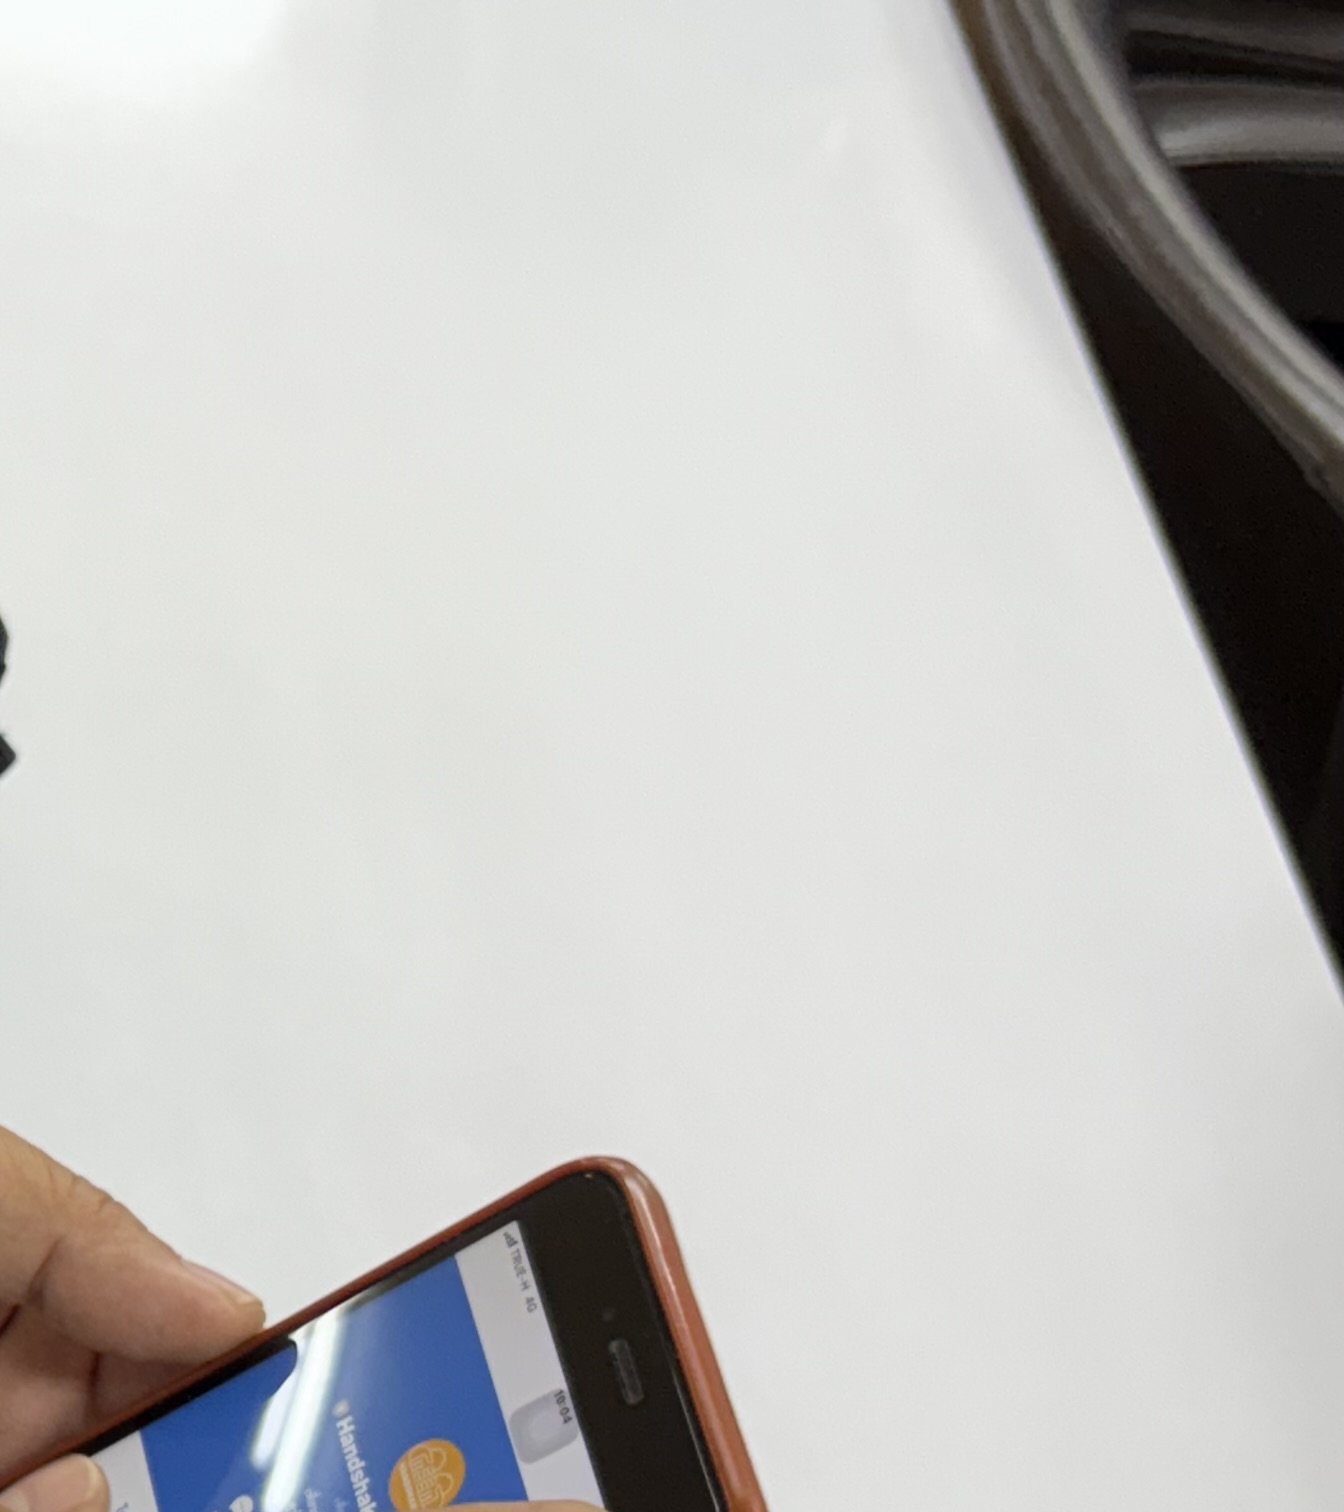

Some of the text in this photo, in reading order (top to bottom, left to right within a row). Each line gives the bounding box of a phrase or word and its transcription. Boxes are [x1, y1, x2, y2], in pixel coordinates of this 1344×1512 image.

[510, 1248, 538, 1313] TRUE-H 4G
[553, 1388, 573, 1425] 10:04
